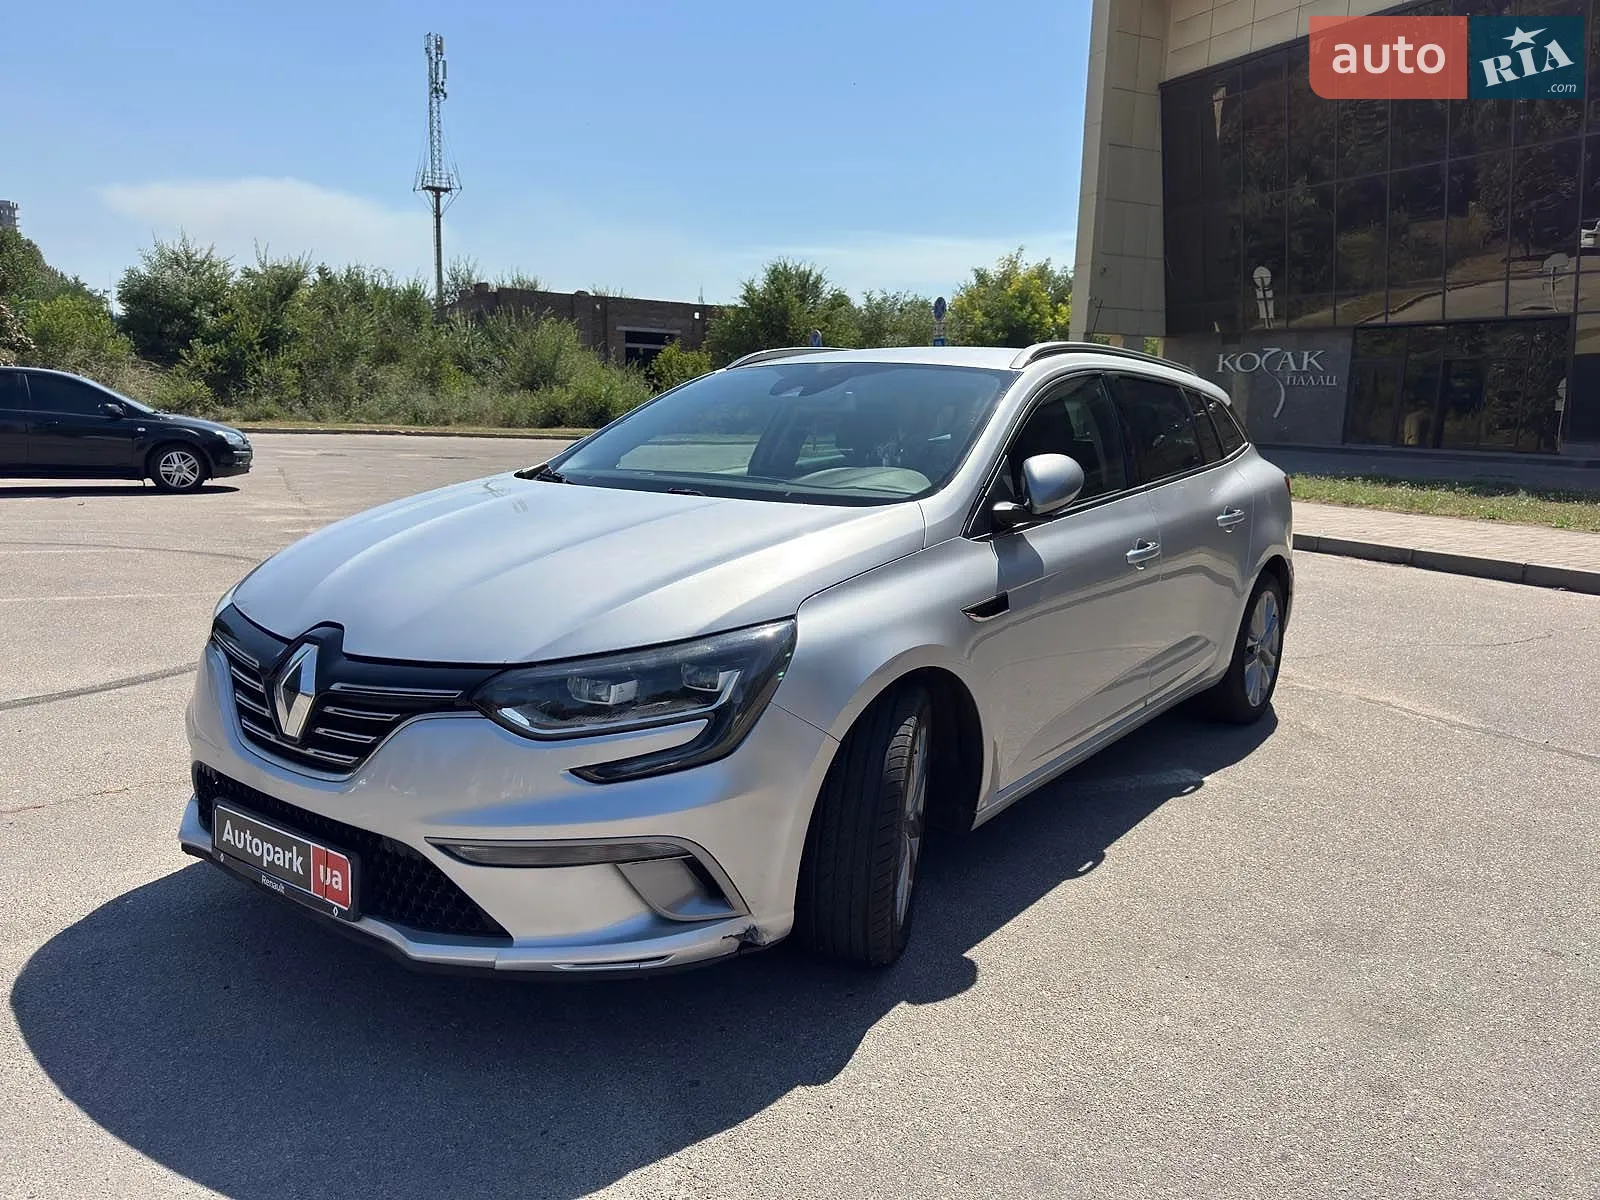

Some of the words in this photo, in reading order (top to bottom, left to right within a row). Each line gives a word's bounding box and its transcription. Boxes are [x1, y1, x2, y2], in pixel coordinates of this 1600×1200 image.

[222, 819, 304, 876] Autopark
[319, 863, 343, 891] ua
[261, 875, 285, 895] Renault
